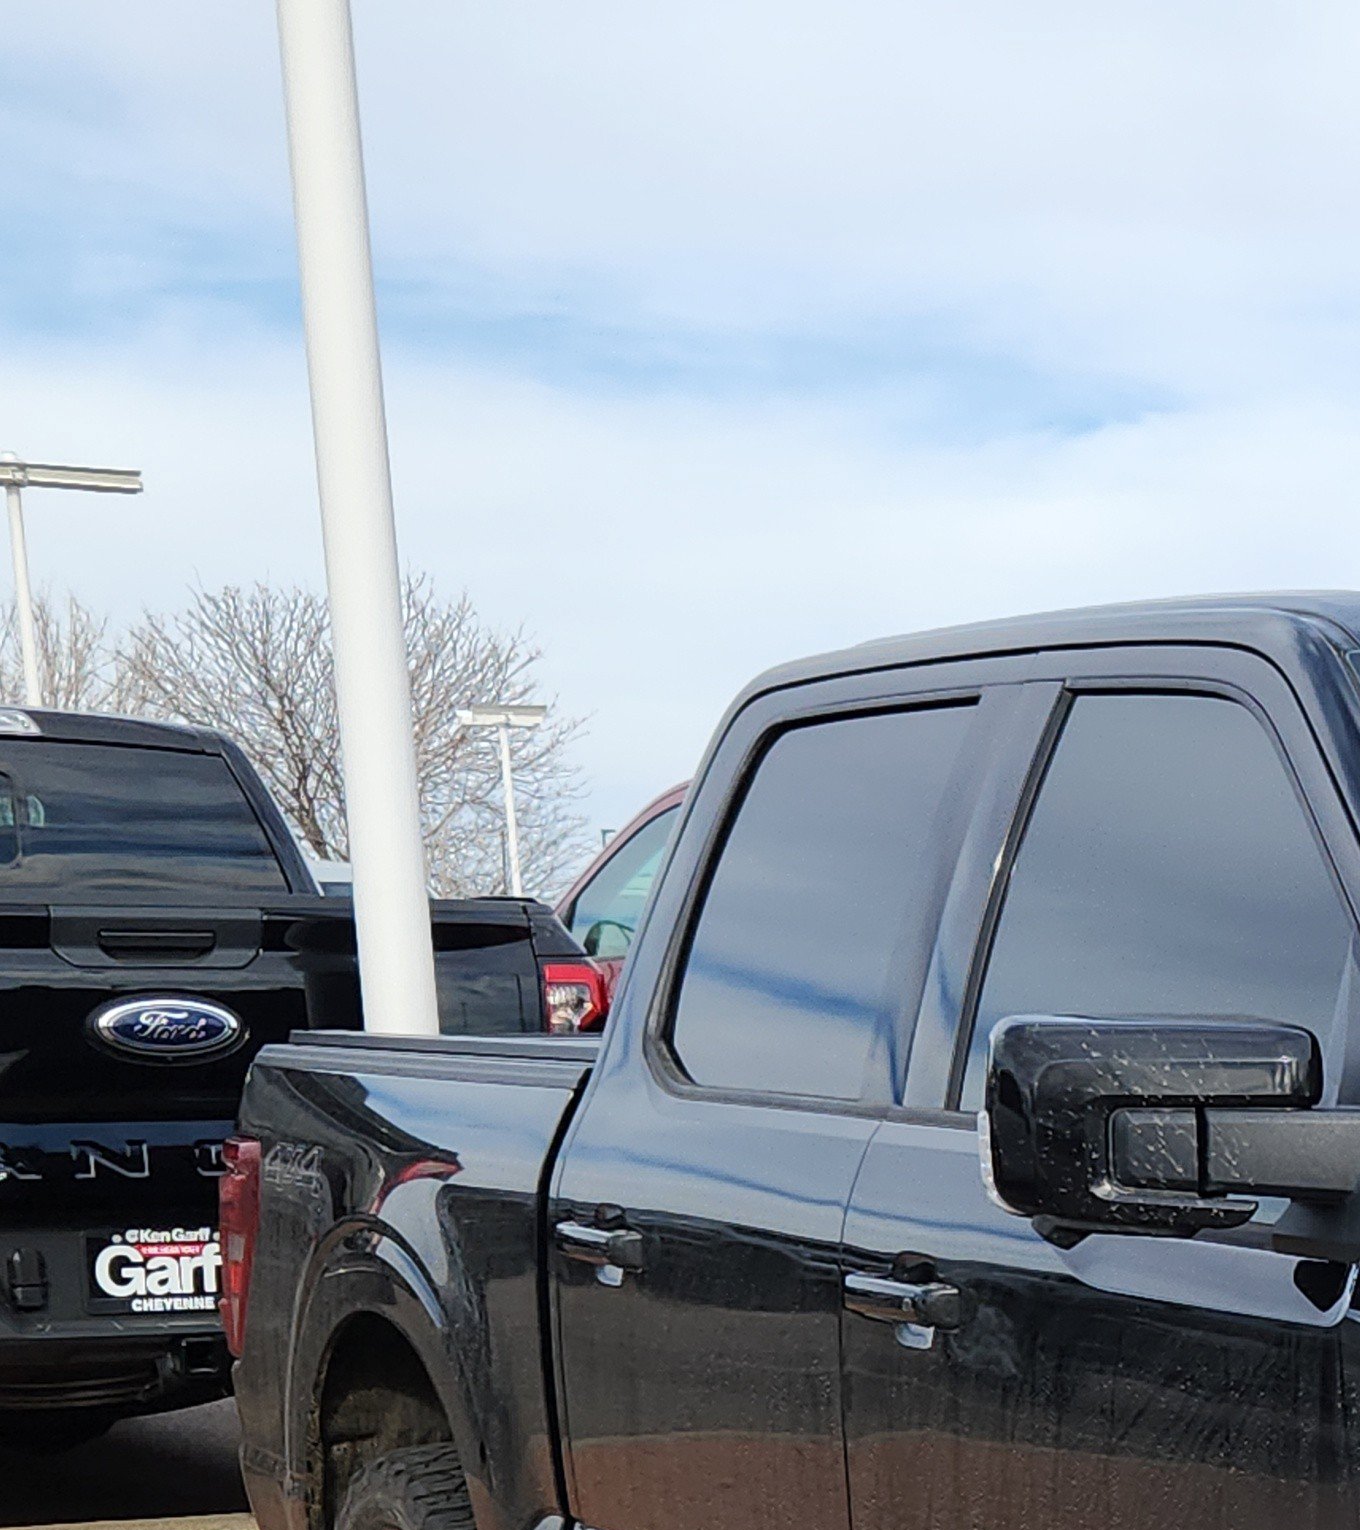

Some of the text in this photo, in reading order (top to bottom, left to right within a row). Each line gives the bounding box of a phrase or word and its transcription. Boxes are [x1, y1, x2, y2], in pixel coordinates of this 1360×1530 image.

[133, 1010, 207, 1039] Ford
[140, 1228, 171, 1243] Ken
[95, 1243, 223, 1297] Garf
[131, 1297, 216, 1312] CHEYENNE
